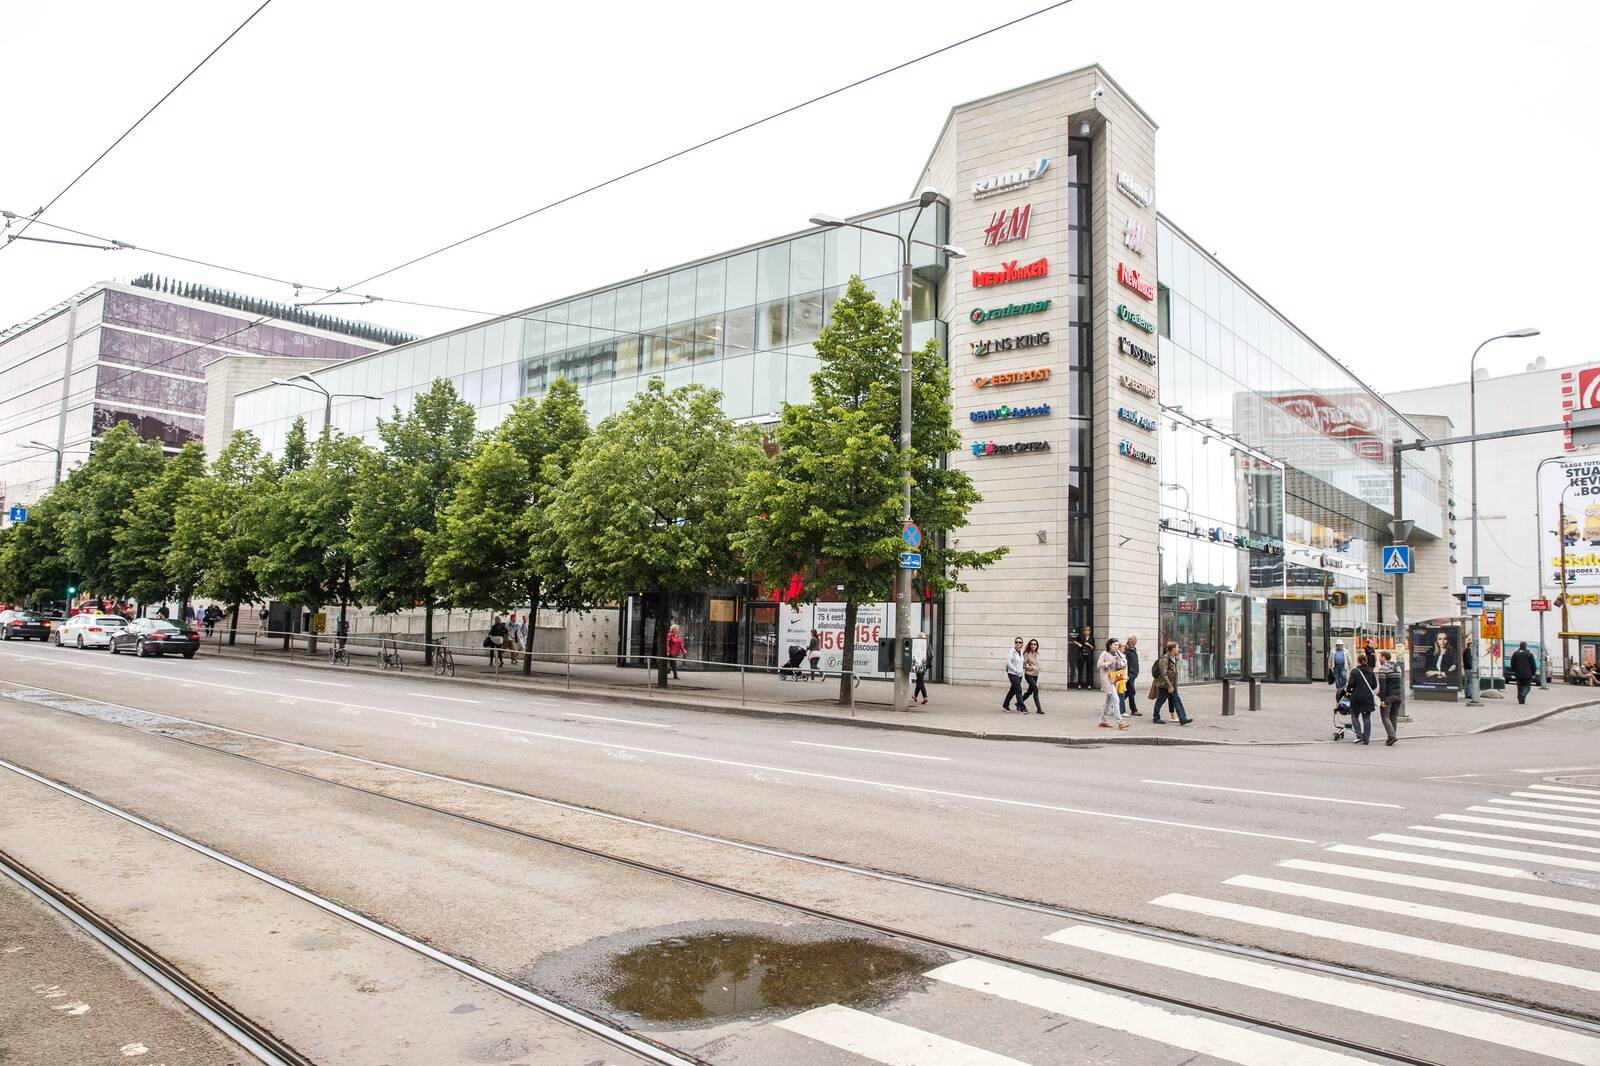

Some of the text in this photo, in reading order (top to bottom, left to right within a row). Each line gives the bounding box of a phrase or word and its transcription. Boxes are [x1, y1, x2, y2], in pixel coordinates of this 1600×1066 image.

[984, 203, 1033, 247] H&M
[1015, 331, 1050, 350] KING
[992, 367, 1051, 385] EESTI POST
[969, 409, 998, 423] BENU
[866, 617, 876, 625] get
[855, 624, 870, 643] 15
